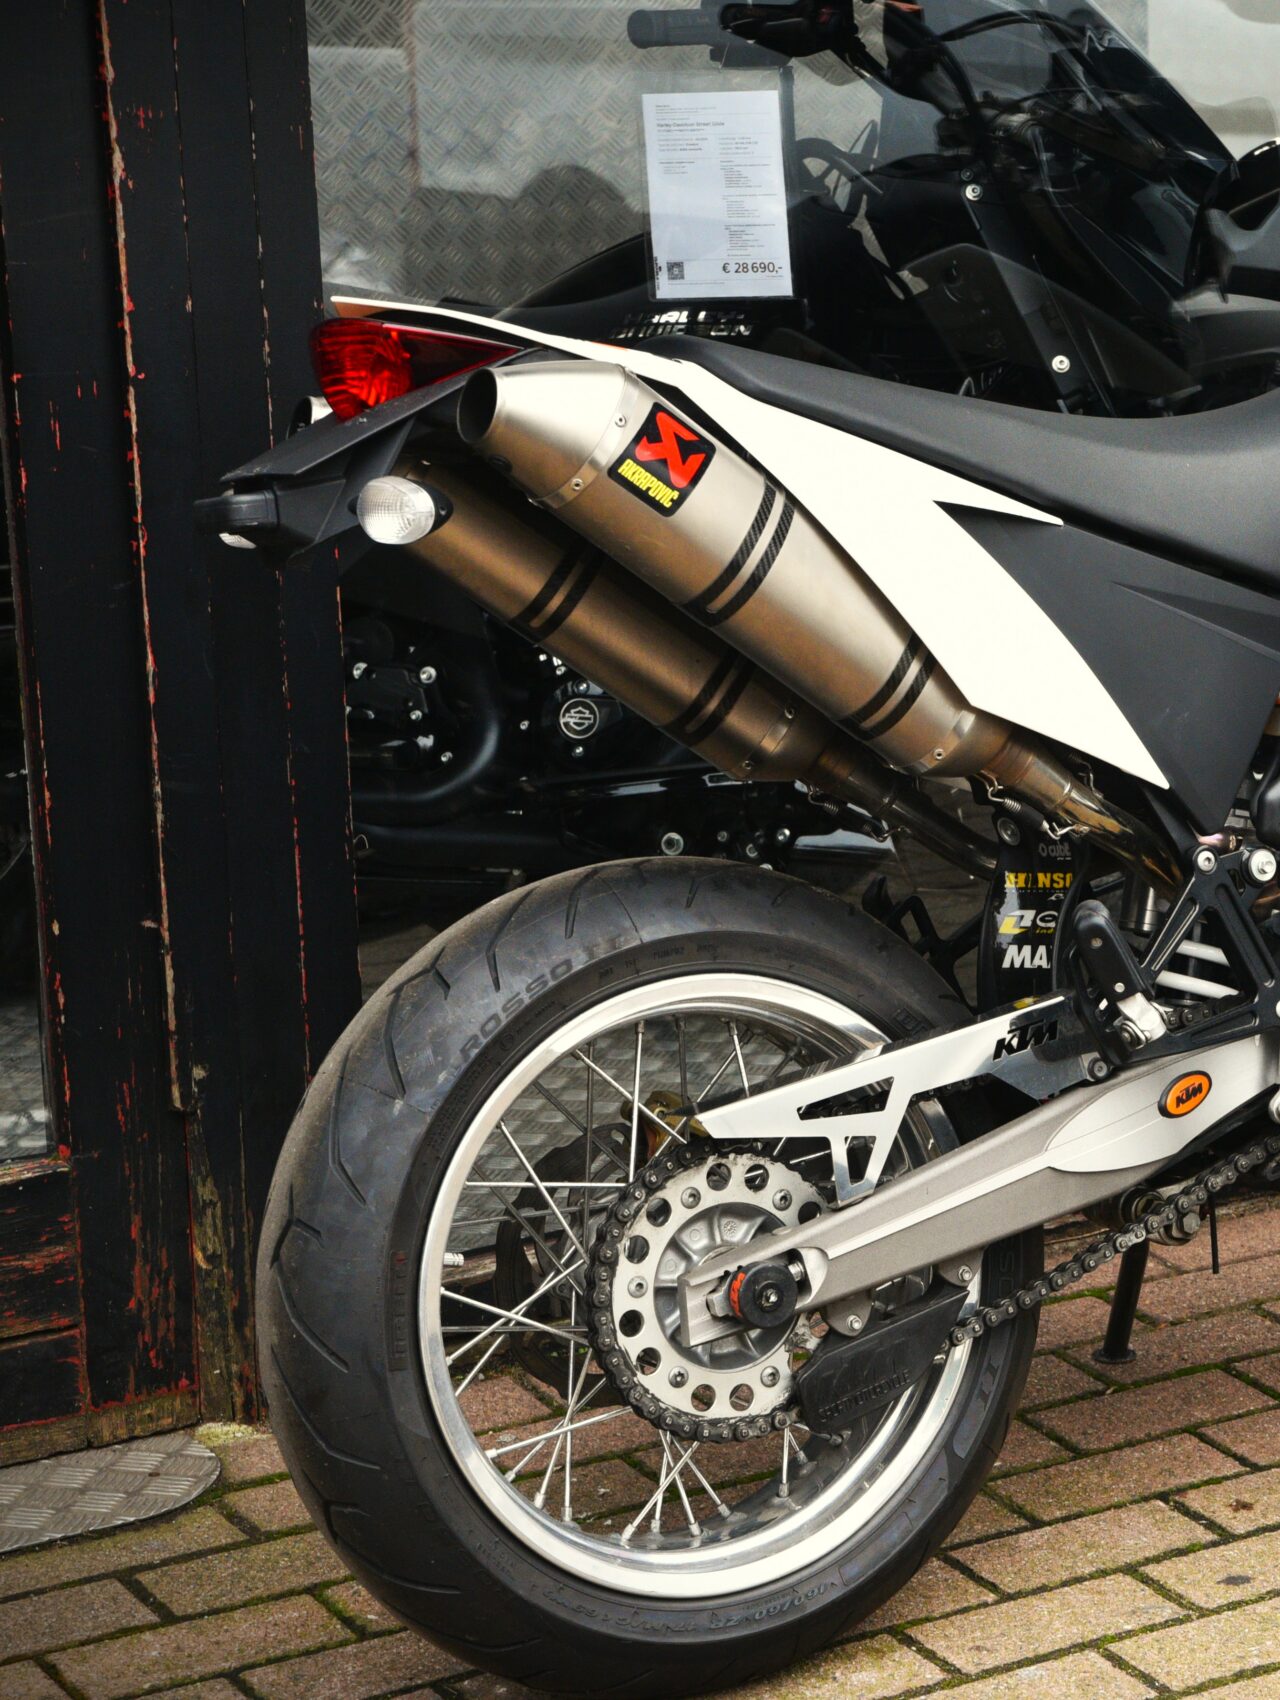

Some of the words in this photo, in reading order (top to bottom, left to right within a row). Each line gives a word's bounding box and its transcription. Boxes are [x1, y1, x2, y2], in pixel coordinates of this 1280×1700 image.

[722, 262, 731, 274] €
[1002, 944, 1052, 969] MA
[460, 958, 574, 1064] ROSSO
[992, 1018, 1058, 1062] KTM
[1175, 1081, 1203, 1109] KTM
